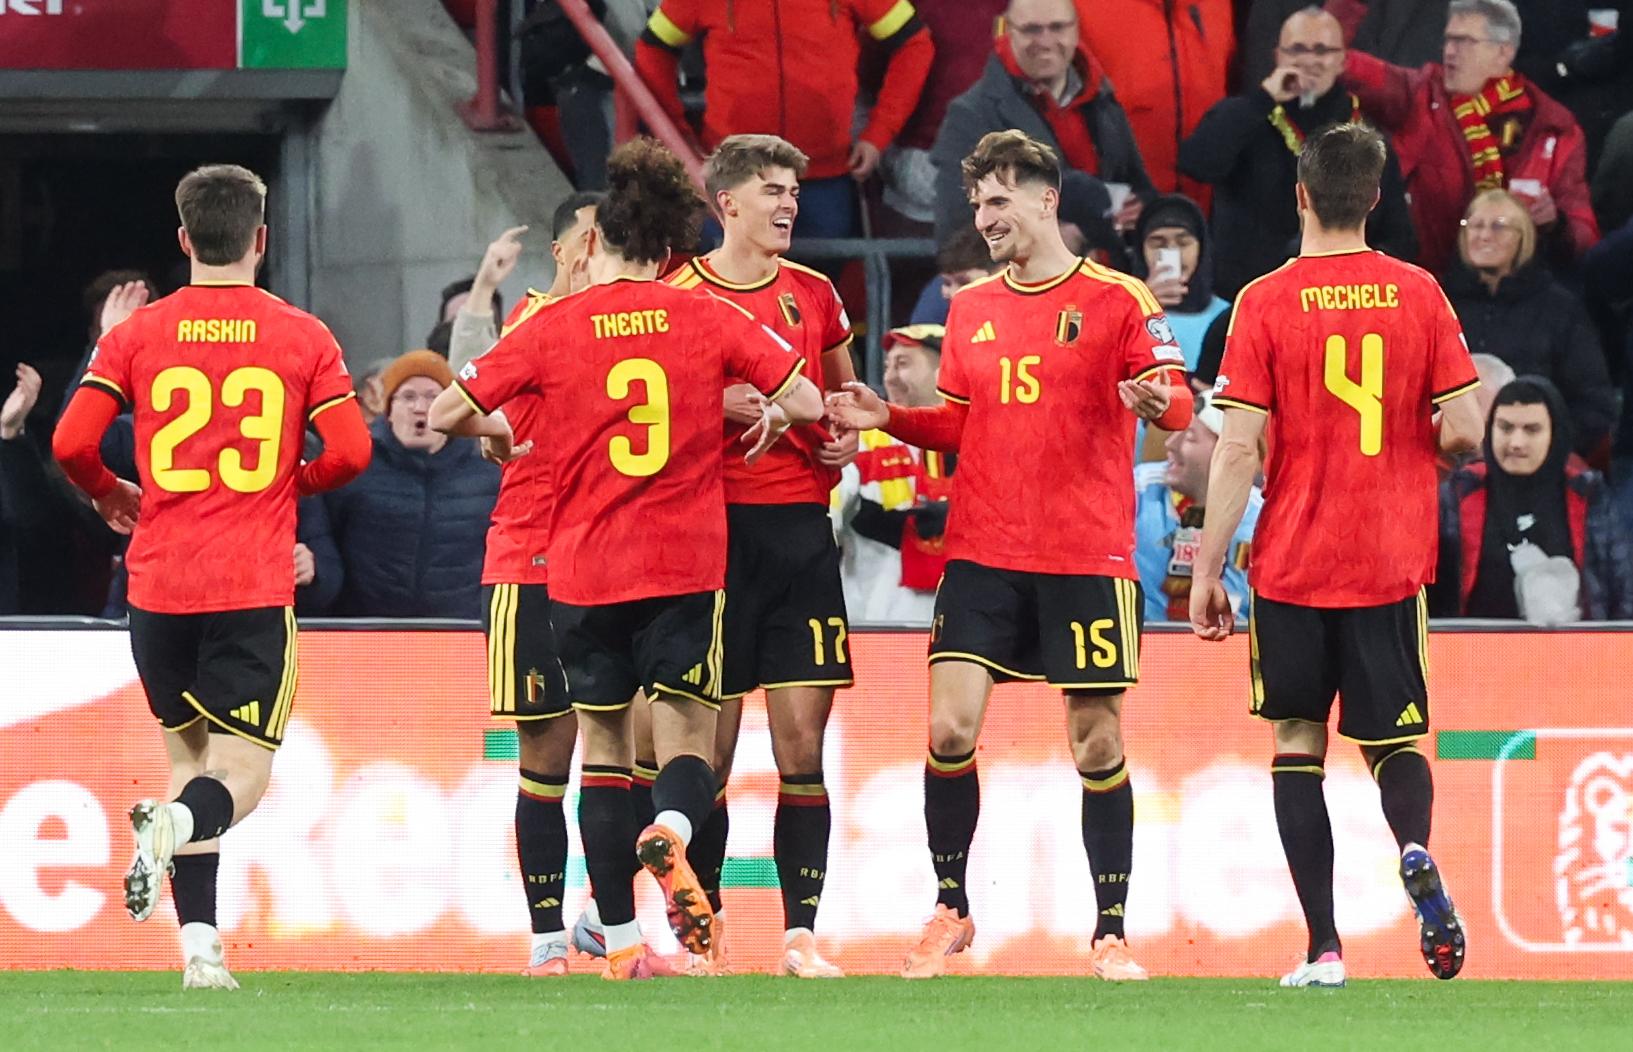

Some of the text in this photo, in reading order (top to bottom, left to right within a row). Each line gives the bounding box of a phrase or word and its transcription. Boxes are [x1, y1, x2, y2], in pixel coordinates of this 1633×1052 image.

[1300, 283, 1399, 313] MECHELE
[177, 319, 256, 343] RASKIN
[590, 309, 669, 339] THEATE
[999, 355, 1041, 405] 15
[1324, 333, 1384, 456] 4
[150, 366, 285, 493] 23
[606, 358, 670, 477] 3
[808, 617, 848, 667] 17
[1070, 618, 1117, 669] 15
